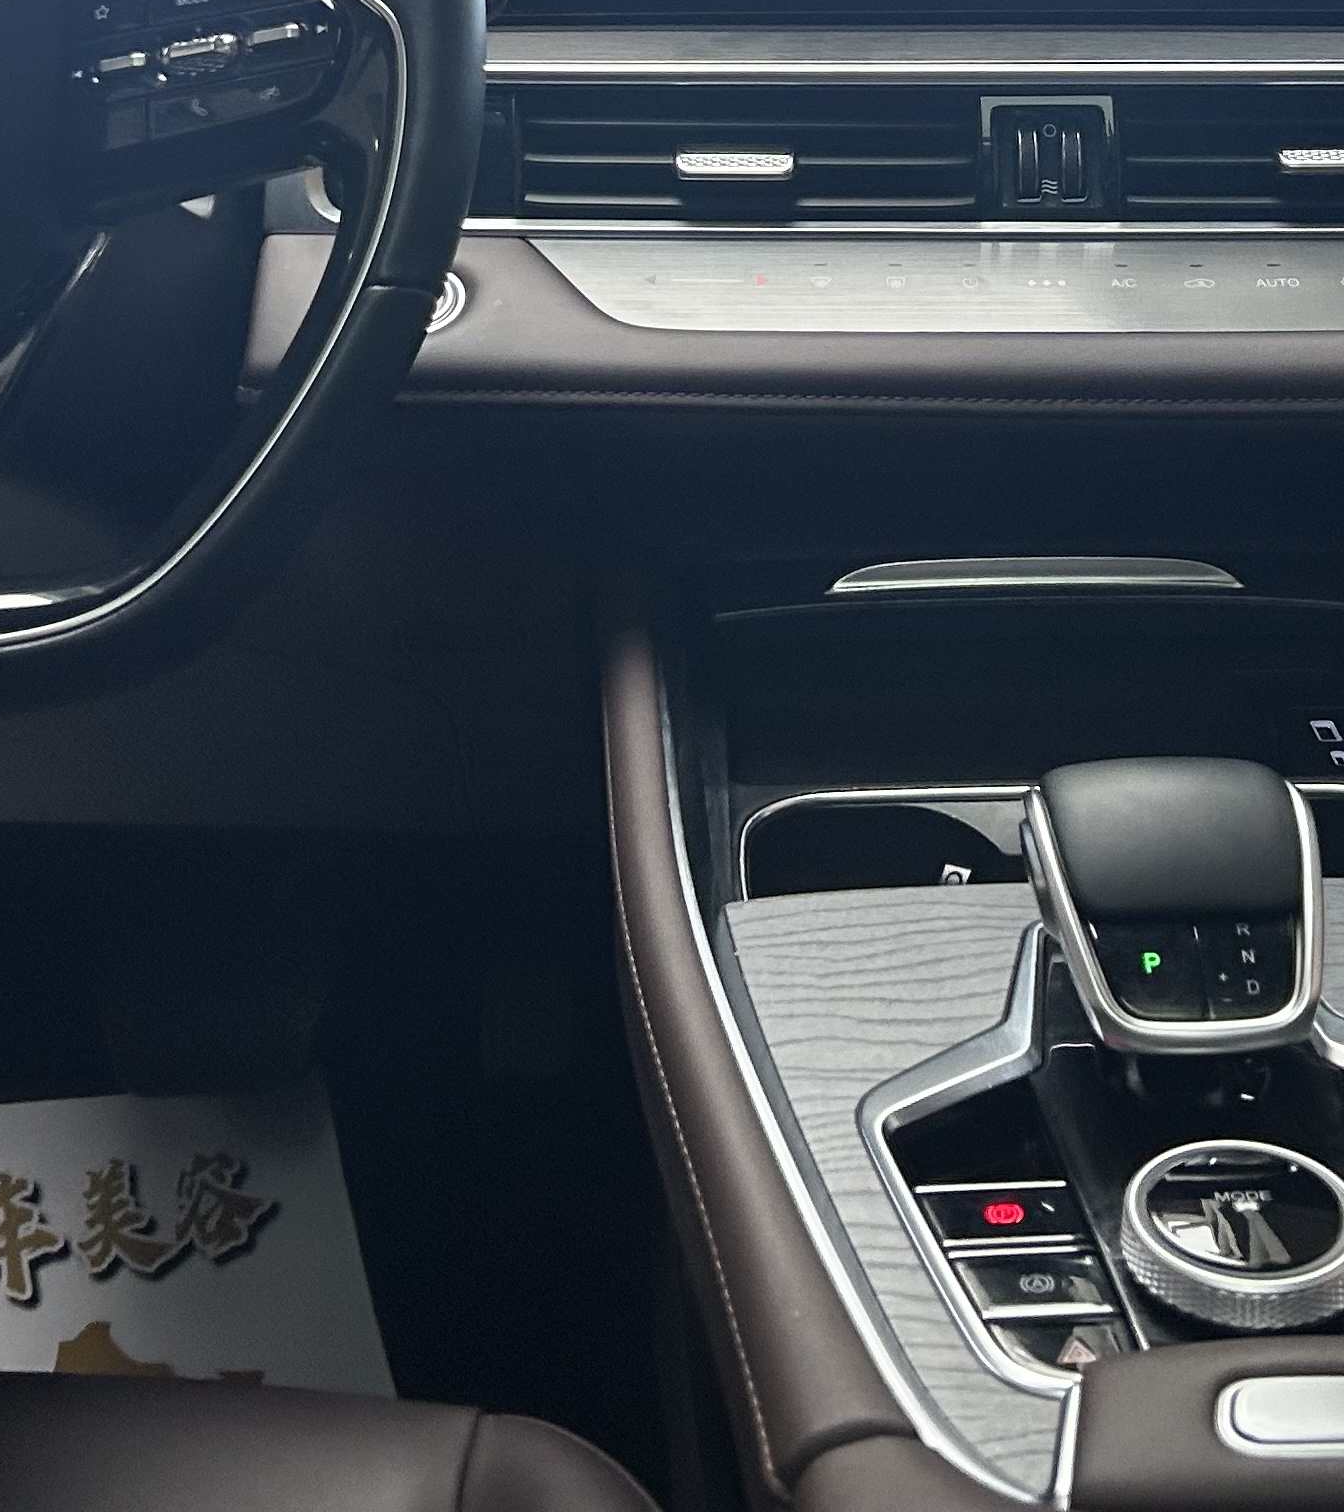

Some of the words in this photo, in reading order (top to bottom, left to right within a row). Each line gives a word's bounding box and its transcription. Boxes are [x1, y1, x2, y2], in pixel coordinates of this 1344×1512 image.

[1111, 278, 1137, 287] A/C
[1256, 278, 1300, 287] AUTO
[1236, 922, 1251, 936] R
[1143, 952, 1161, 974] P
[1241, 948, 1256, 964] N
[1246, 979, 1261, 995] D
[1214, 1190, 1273, 1202] MODE
